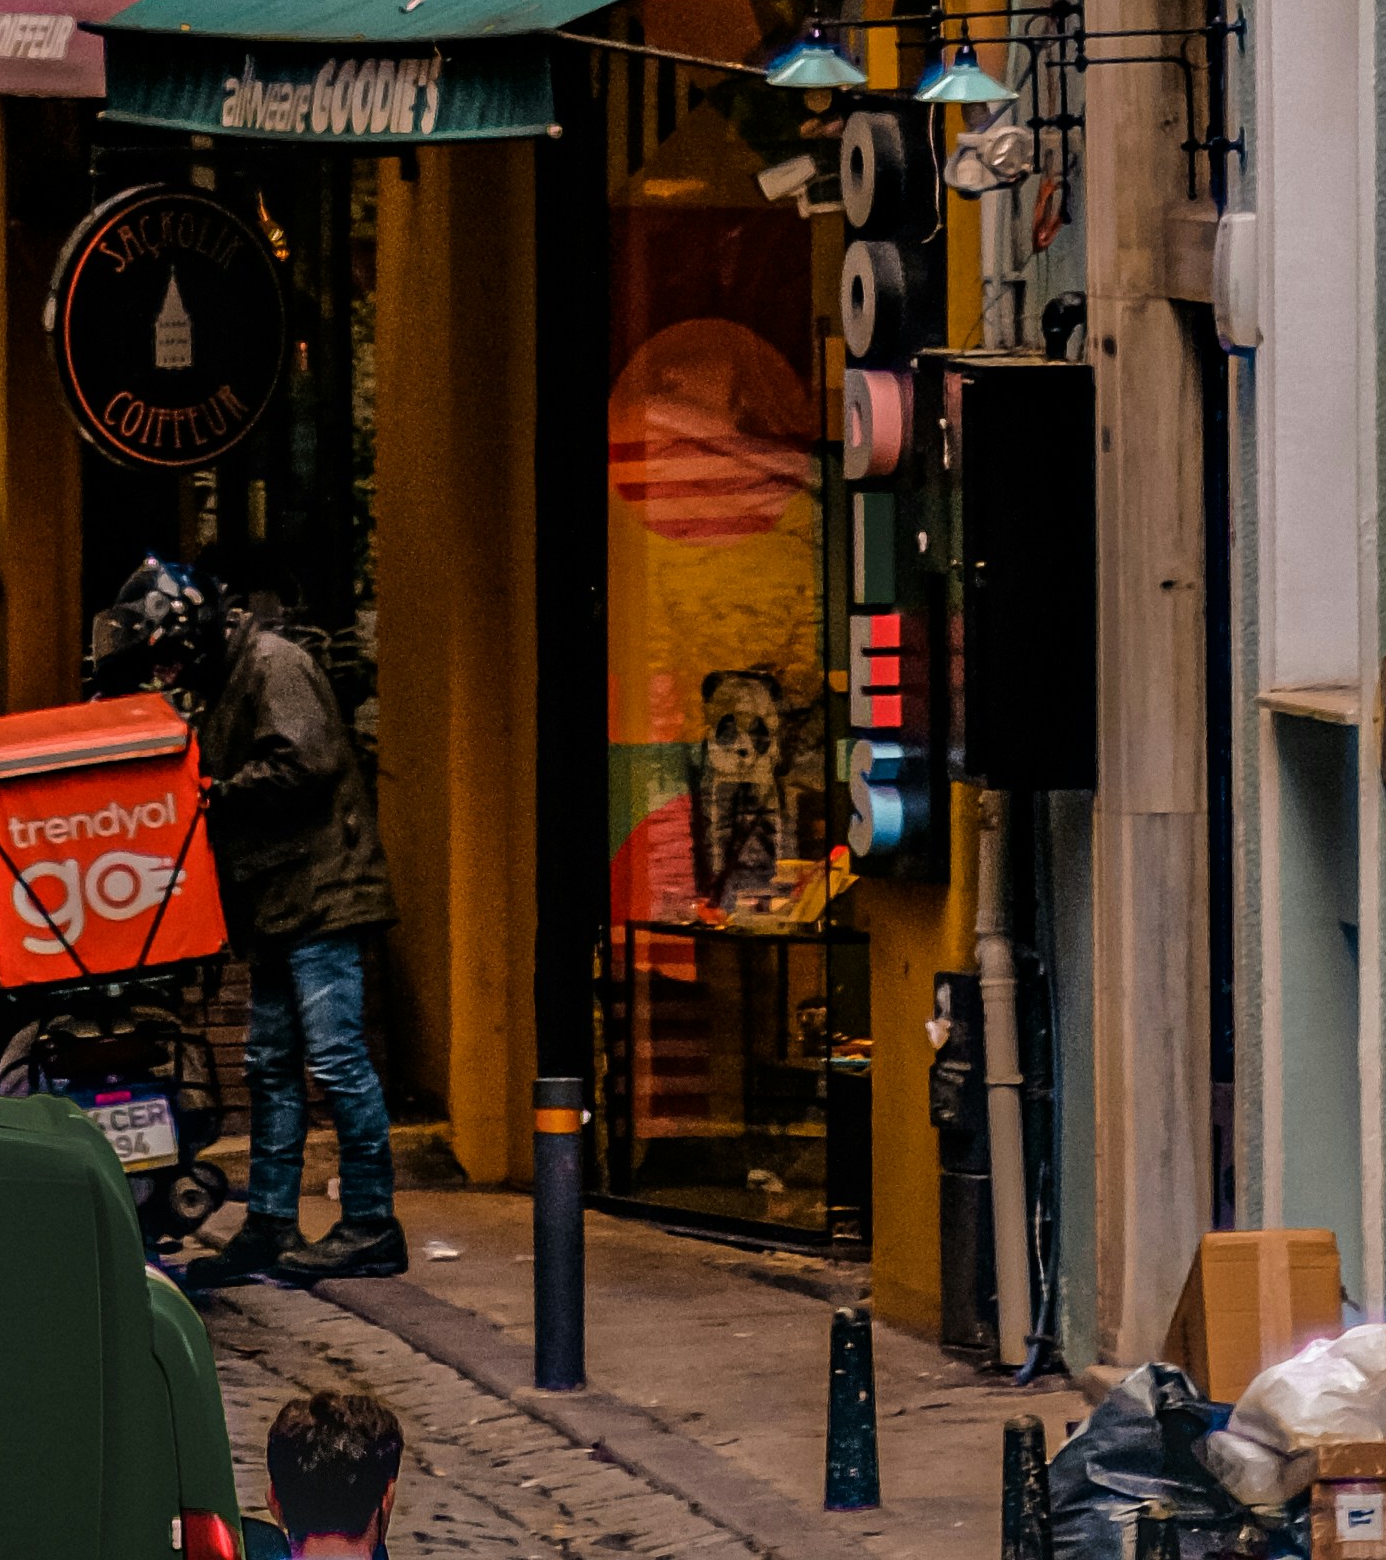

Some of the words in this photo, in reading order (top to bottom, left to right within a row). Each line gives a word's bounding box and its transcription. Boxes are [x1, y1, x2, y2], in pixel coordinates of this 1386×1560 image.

[102, 382, 250, 450] COIFFEUR
[8, 792, 179, 850] trendyol
[12, 849, 187, 956] go
